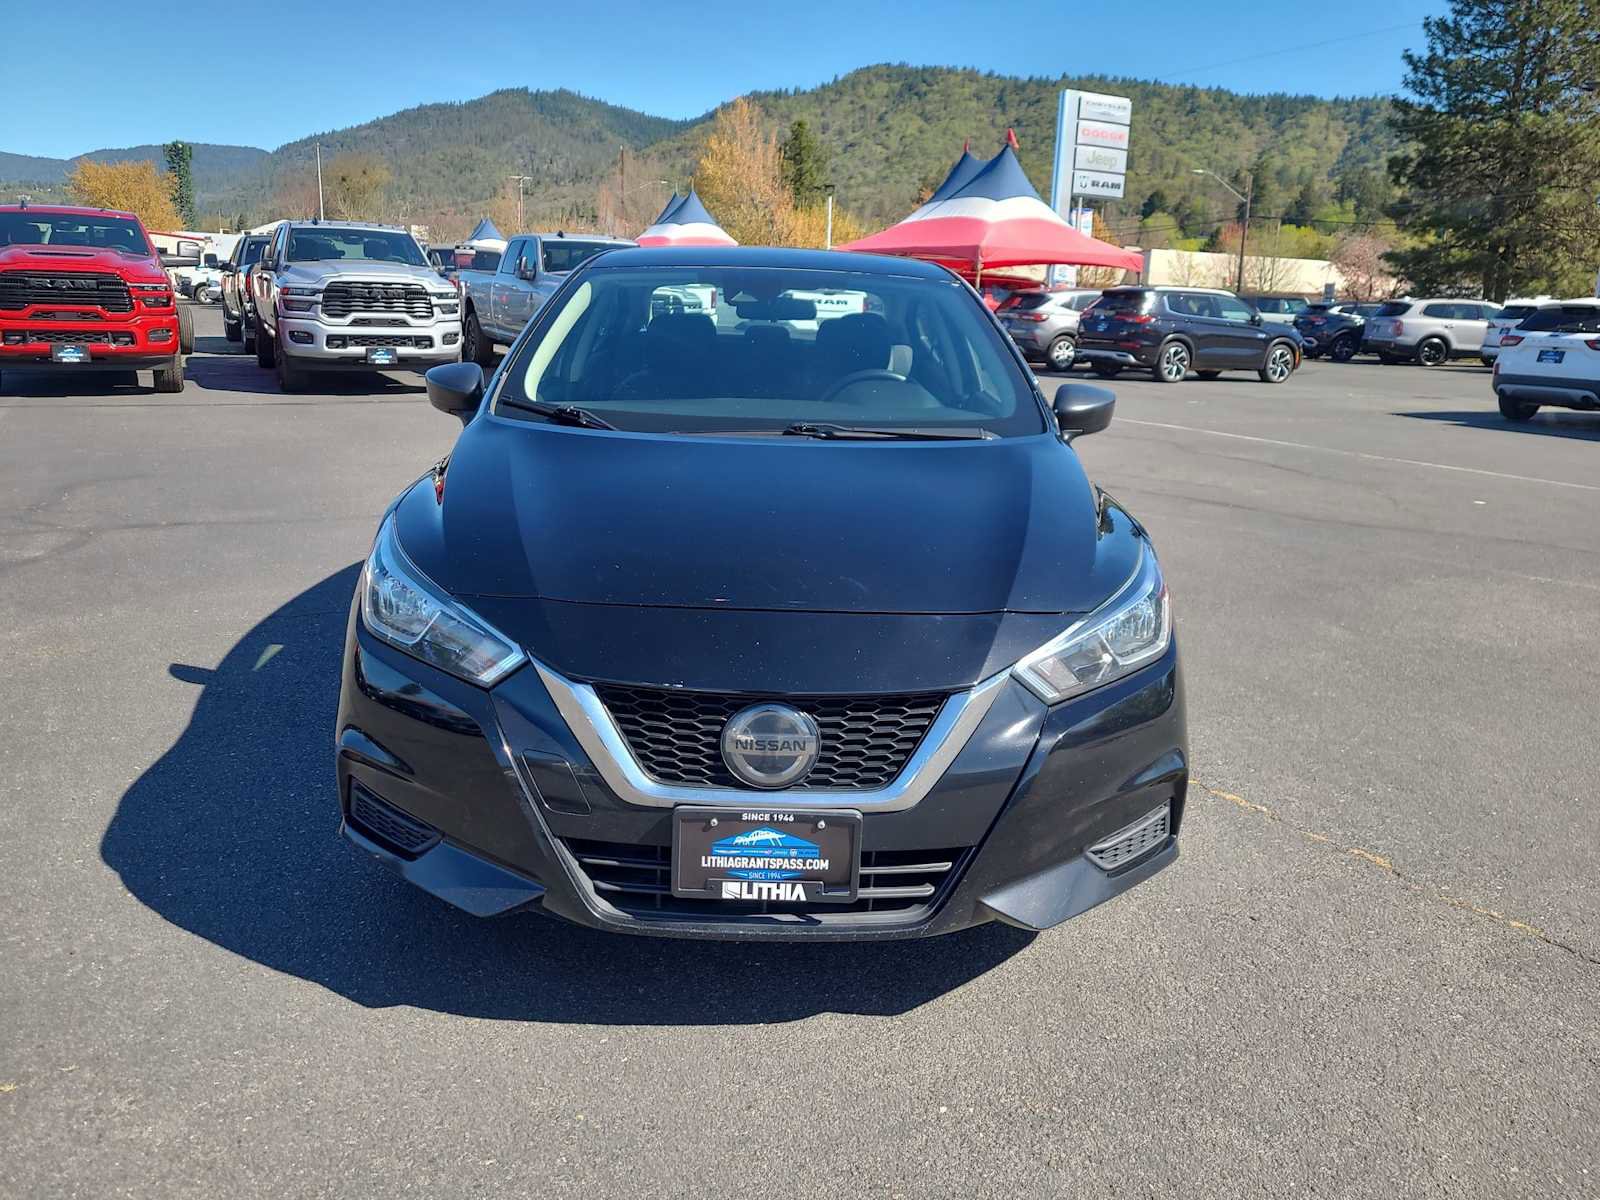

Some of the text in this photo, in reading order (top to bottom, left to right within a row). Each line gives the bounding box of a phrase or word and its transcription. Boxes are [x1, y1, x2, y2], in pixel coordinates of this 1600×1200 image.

[1087, 150, 1117, 169] Jeep
[1091, 180, 1121, 190] RAM
[30, 277, 97, 289] RAM
[735, 738, 806, 751] NISSAN
[742, 813, 794, 822] SINCE 1946
[701, 856, 829, 870] LITHIAGRANTSPASS.COM
[748, 871, 765, 879] SINCE
[742, 882, 807, 901] LITHIA
